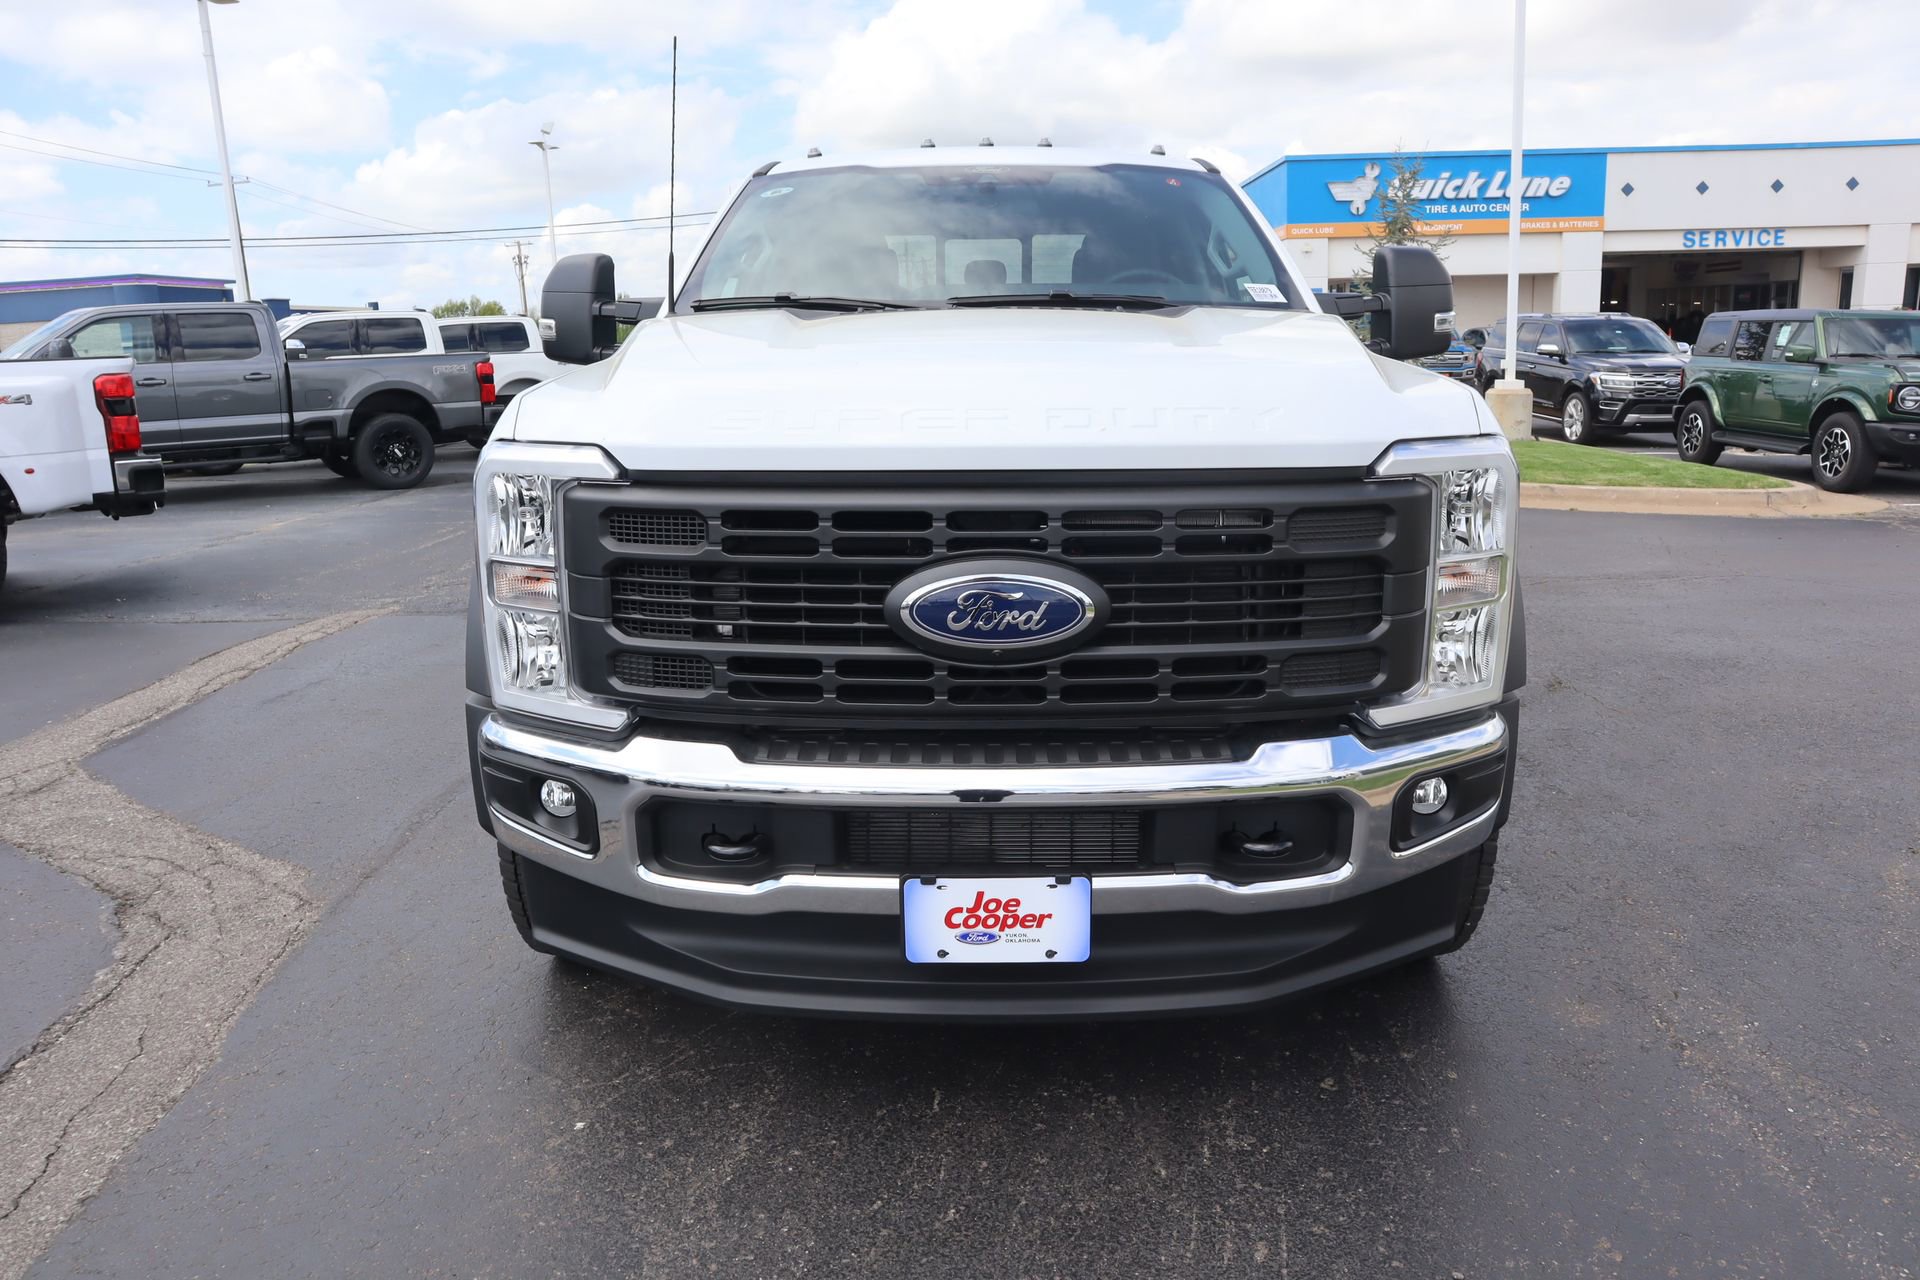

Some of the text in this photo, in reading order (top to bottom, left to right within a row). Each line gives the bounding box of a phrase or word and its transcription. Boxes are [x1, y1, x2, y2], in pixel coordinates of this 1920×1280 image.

[1388, 171, 1487, 200] Quick
[1425, 203, 1530, 214] TIRE & AUTO CENR
[1291, 226, 1335, 235] QUICK LUBE
[1552, 221, 1558, 229] &
[1559, 220, 1600, 228] BATTERIES
[1683, 229, 1787, 248] SERVICE
[708, 406, 1286, 434] SUPER DUTY
[946, 589, 1050, 631] Ford
[965, 891, 1021, 914] Joe
[944, 907, 1053, 932] Cooper
[966, 931, 990, 942] Ford
